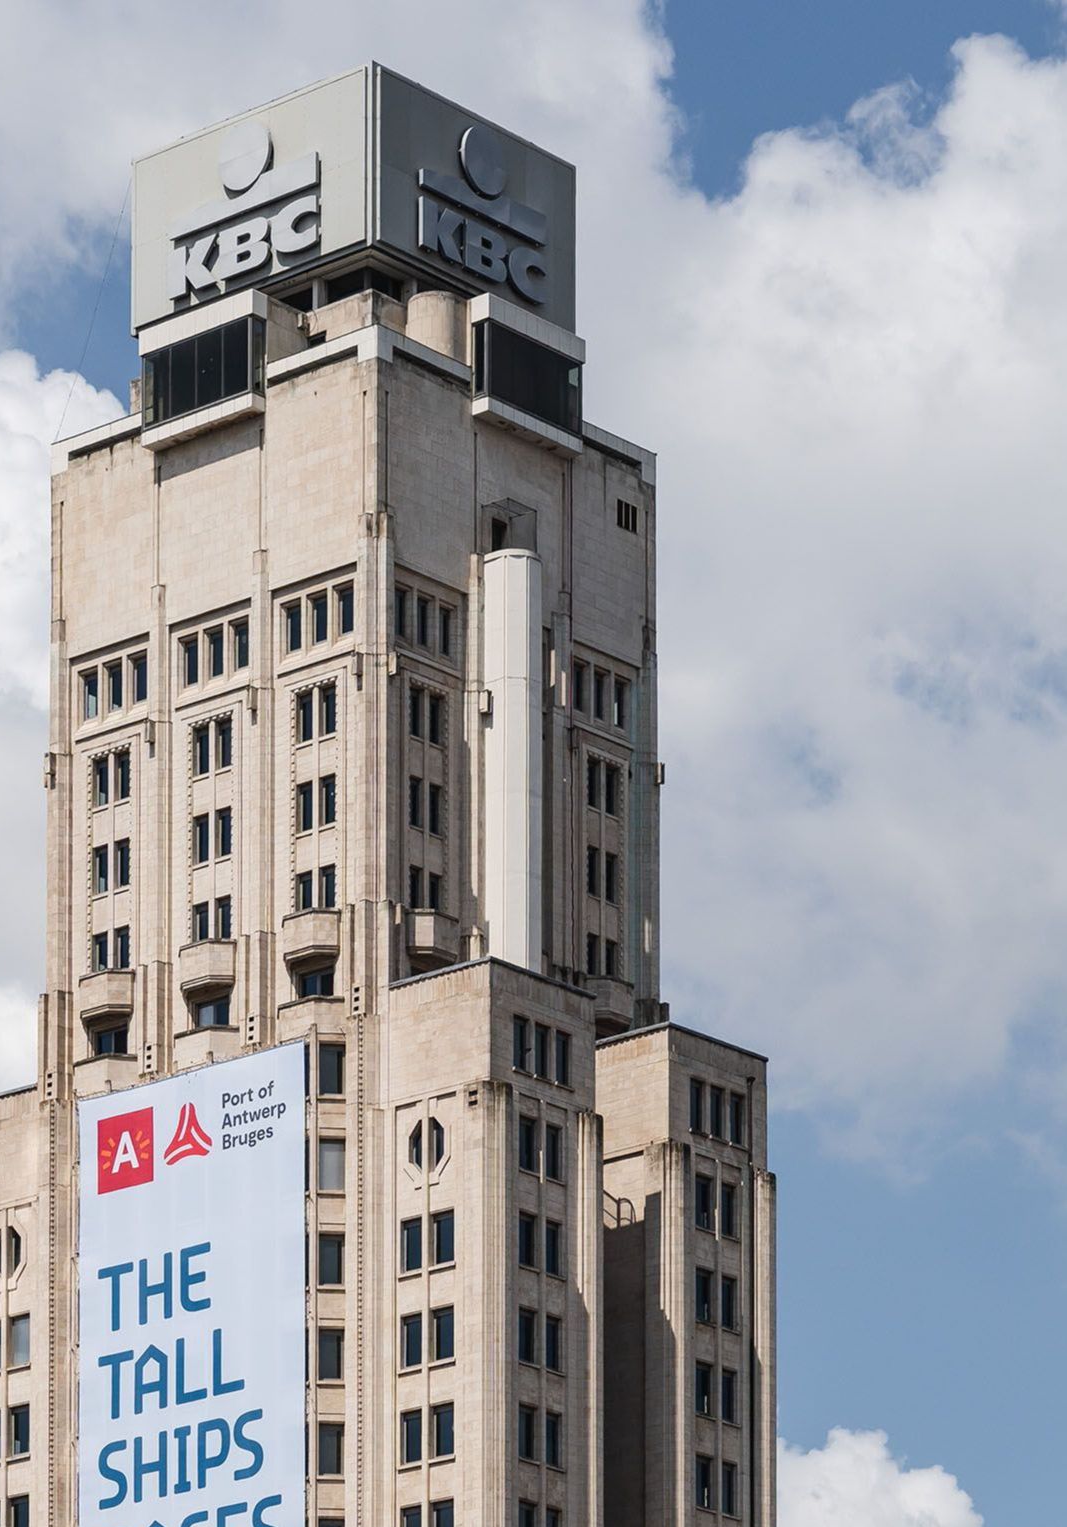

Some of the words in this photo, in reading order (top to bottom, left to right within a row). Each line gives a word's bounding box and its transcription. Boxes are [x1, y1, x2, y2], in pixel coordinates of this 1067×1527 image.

[169, 195, 320, 301] KBC
[418, 196, 547, 304] KBC
[221, 1089, 254, 1108] Port
[258, 1080, 275, 1099] of
[221, 1101, 287, 1130] Antwerp
[221, 1126, 274, 1150] Bruges
[111, 1131, 140, 1174] A
[97, 1241, 211, 1332] THE
[97, 1328, 246, 1420] TALL
[97, 1408, 265, 1511] SHIPS
